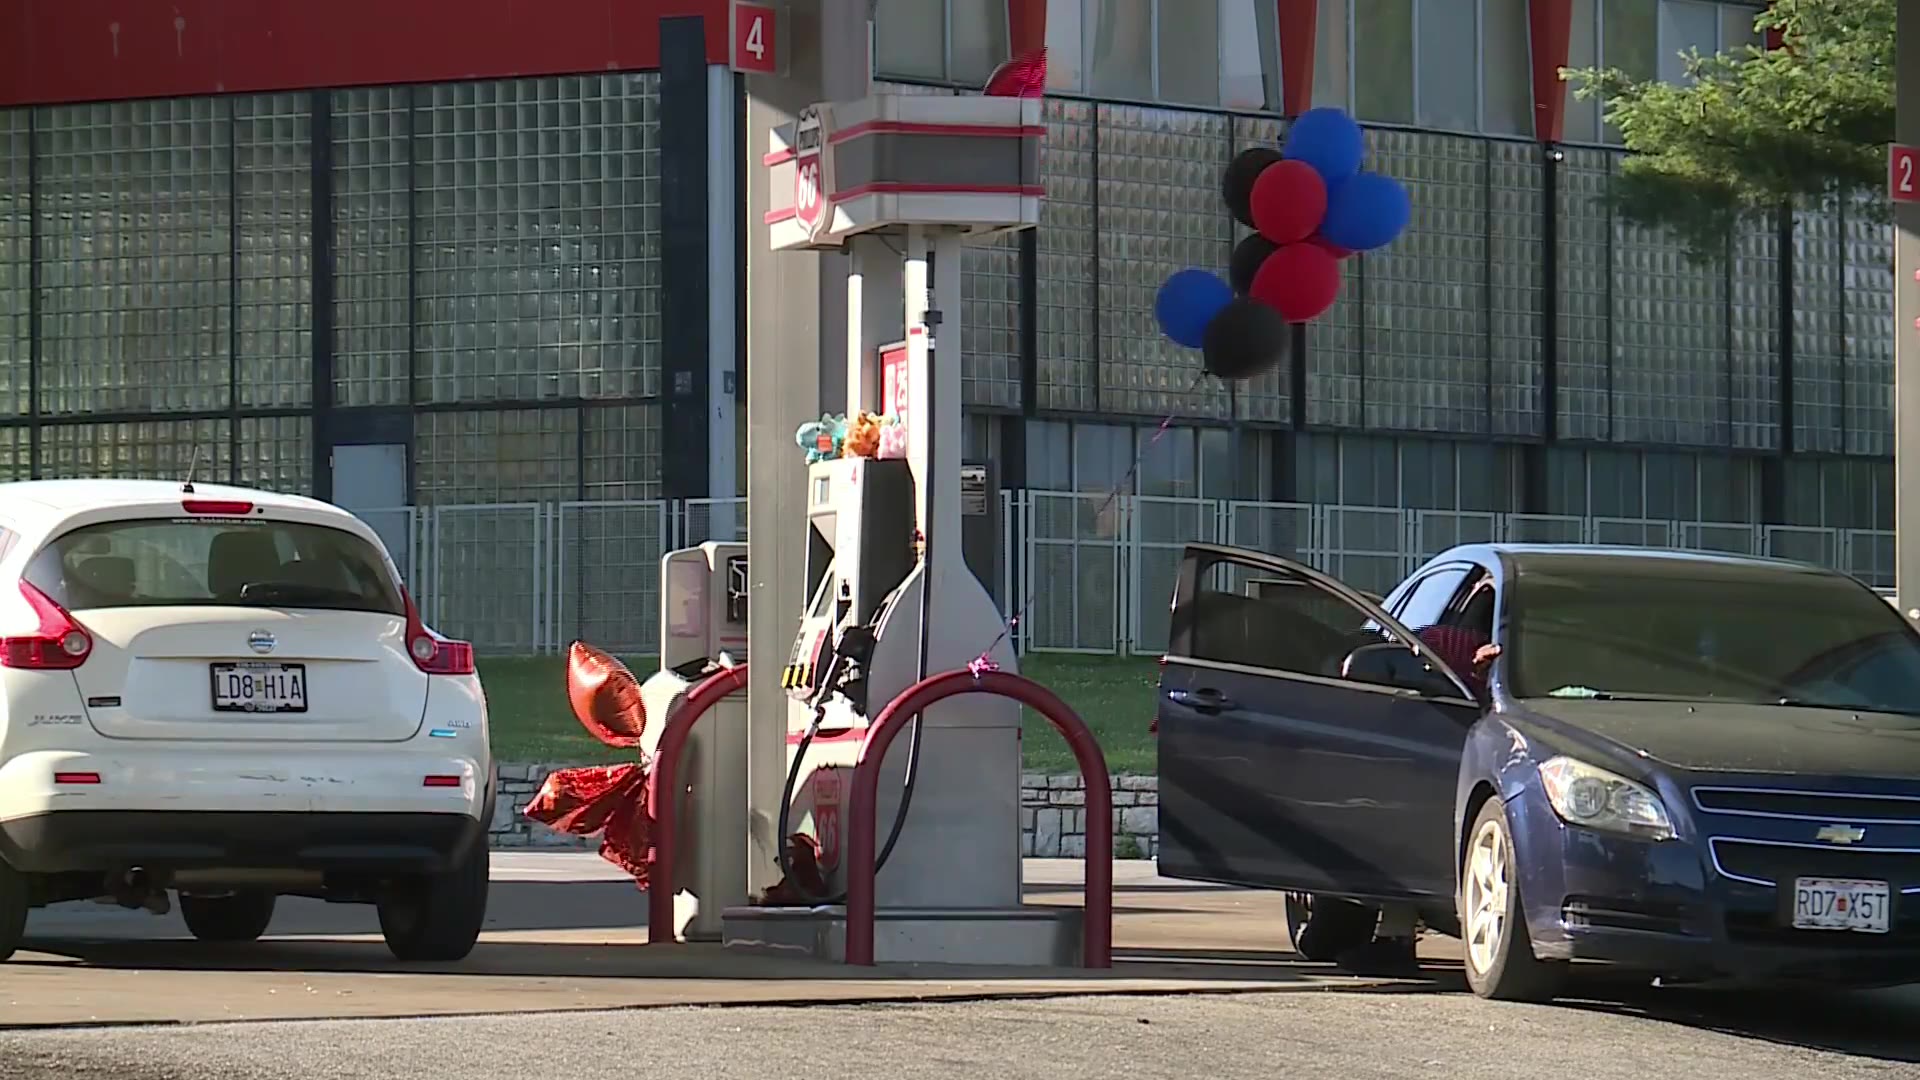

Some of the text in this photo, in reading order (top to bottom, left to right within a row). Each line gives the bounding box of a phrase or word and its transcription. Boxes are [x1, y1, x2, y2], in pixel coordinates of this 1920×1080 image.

[746, 17, 763, 59] 4
[798, 162, 817, 211] 66
[1900, 155, 1912, 192] 2
[216, 674, 301, 699] LD8 H1A
[1798, 889, 1887, 920] RD7 X5T
